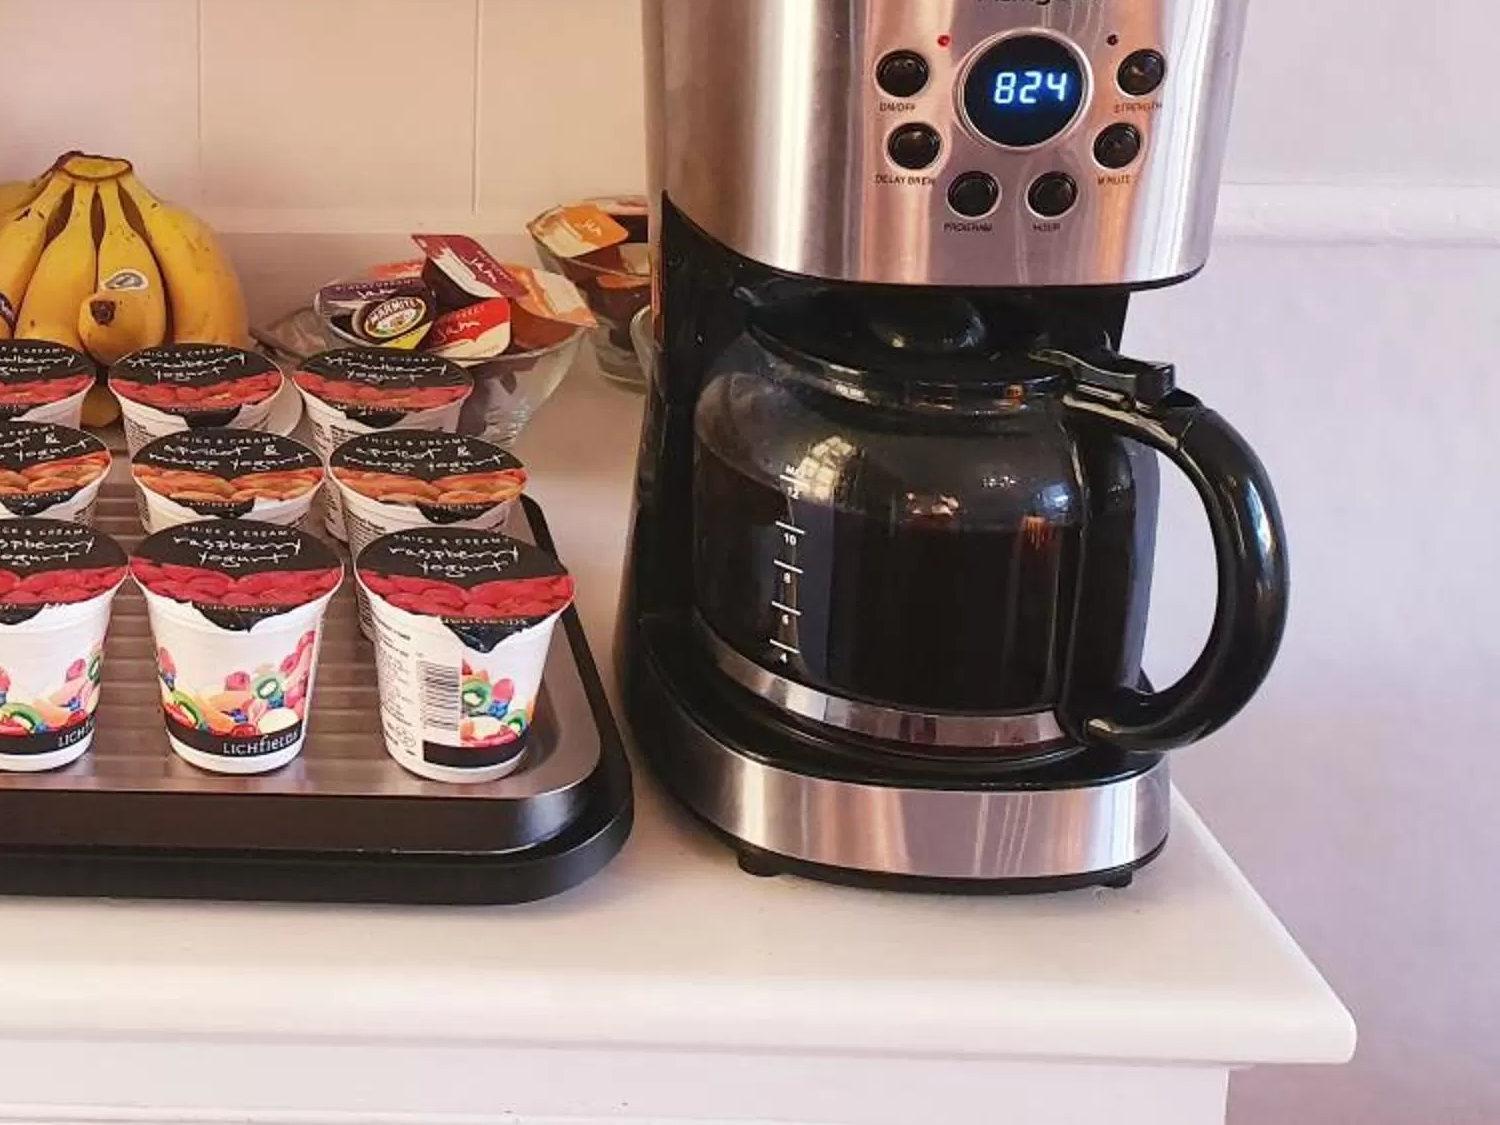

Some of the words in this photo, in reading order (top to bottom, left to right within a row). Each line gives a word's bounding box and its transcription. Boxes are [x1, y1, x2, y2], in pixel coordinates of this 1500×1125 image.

[993, 70, 1068, 104] 824
[879, 103, 916, 112] ON/OFF
[875, 174, 905, 185] DELAY
[369, 296, 419, 325] MARMITE
[355, 447, 443, 459] apricot
[173, 536, 301, 555] raspberry
[784, 533, 797, 545] 10
[198, 551, 289, 568] yogurt
[388, 545, 519, 562] raspberry
[416, 559, 509, 578] yogurt
[779, 652, 787, 663] 4
